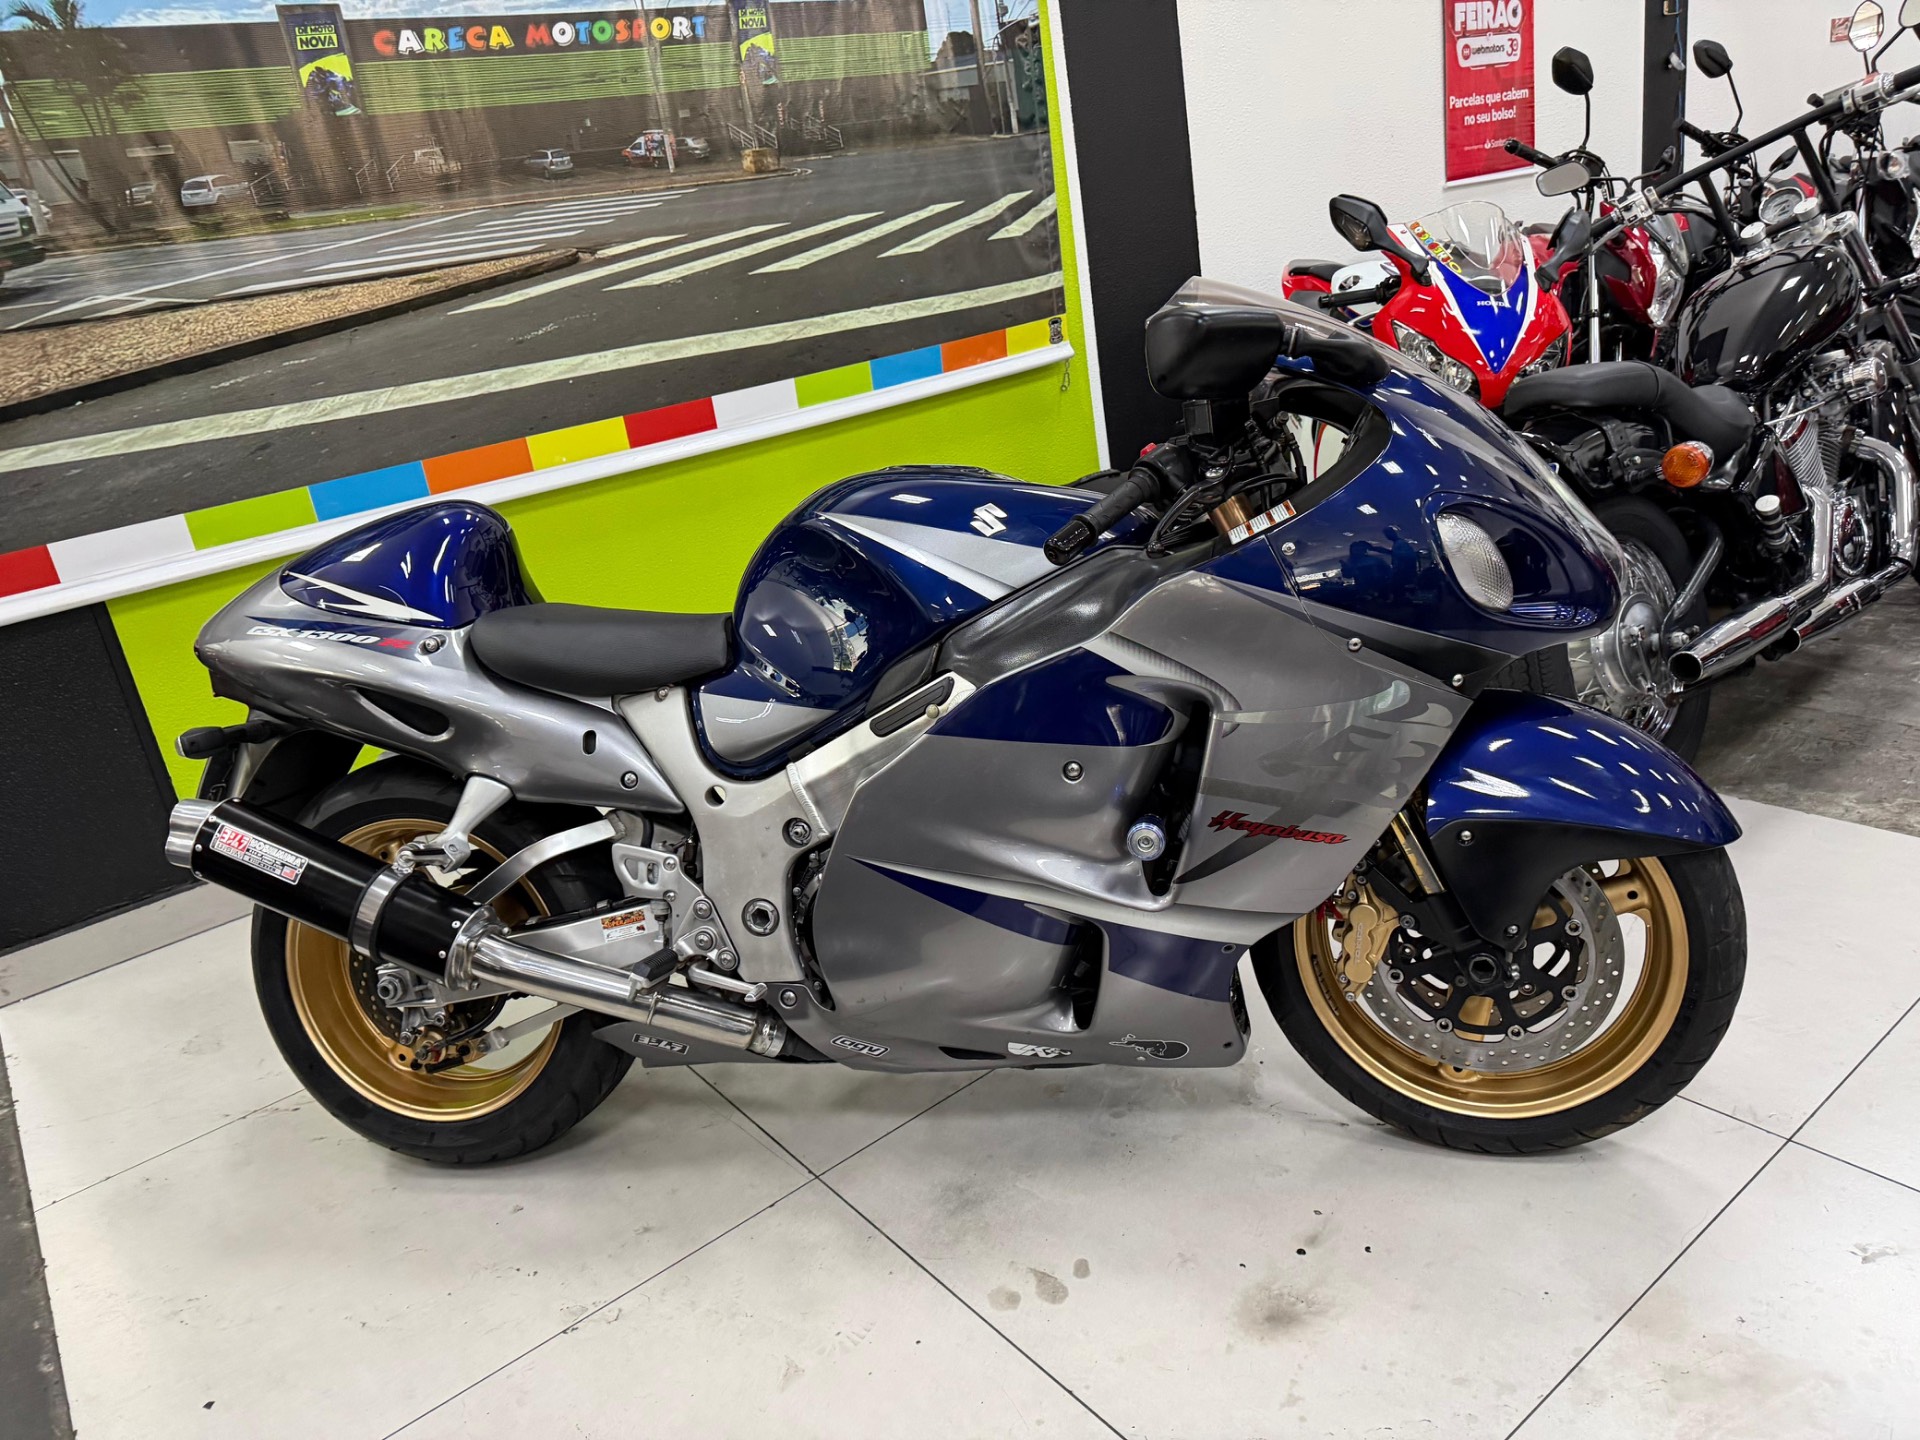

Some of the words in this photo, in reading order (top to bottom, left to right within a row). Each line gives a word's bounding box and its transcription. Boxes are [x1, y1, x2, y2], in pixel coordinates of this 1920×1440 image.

[310, 25, 334, 34] MOTO
[741, 17, 765, 28] NOVA
[299, 35, 336, 49] NOVA
[373, 25, 515, 55] CARECA
[525, 15, 706, 48] MOTOSPORT
[1471, 43, 1505, 55] webmotors
[1506, 38, 1518, 56] 30
[1449, 93, 1485, 109] Parcelas
[1485, 92, 1501, 106] que
[1502, 87, 1529, 101] cabem
[1464, 115, 1475, 126] no
[1476, 112, 1491, 124] seu
[1491, 105, 1516, 121] bolso!
[1207, 810, 1351, 844] Hayabusa
